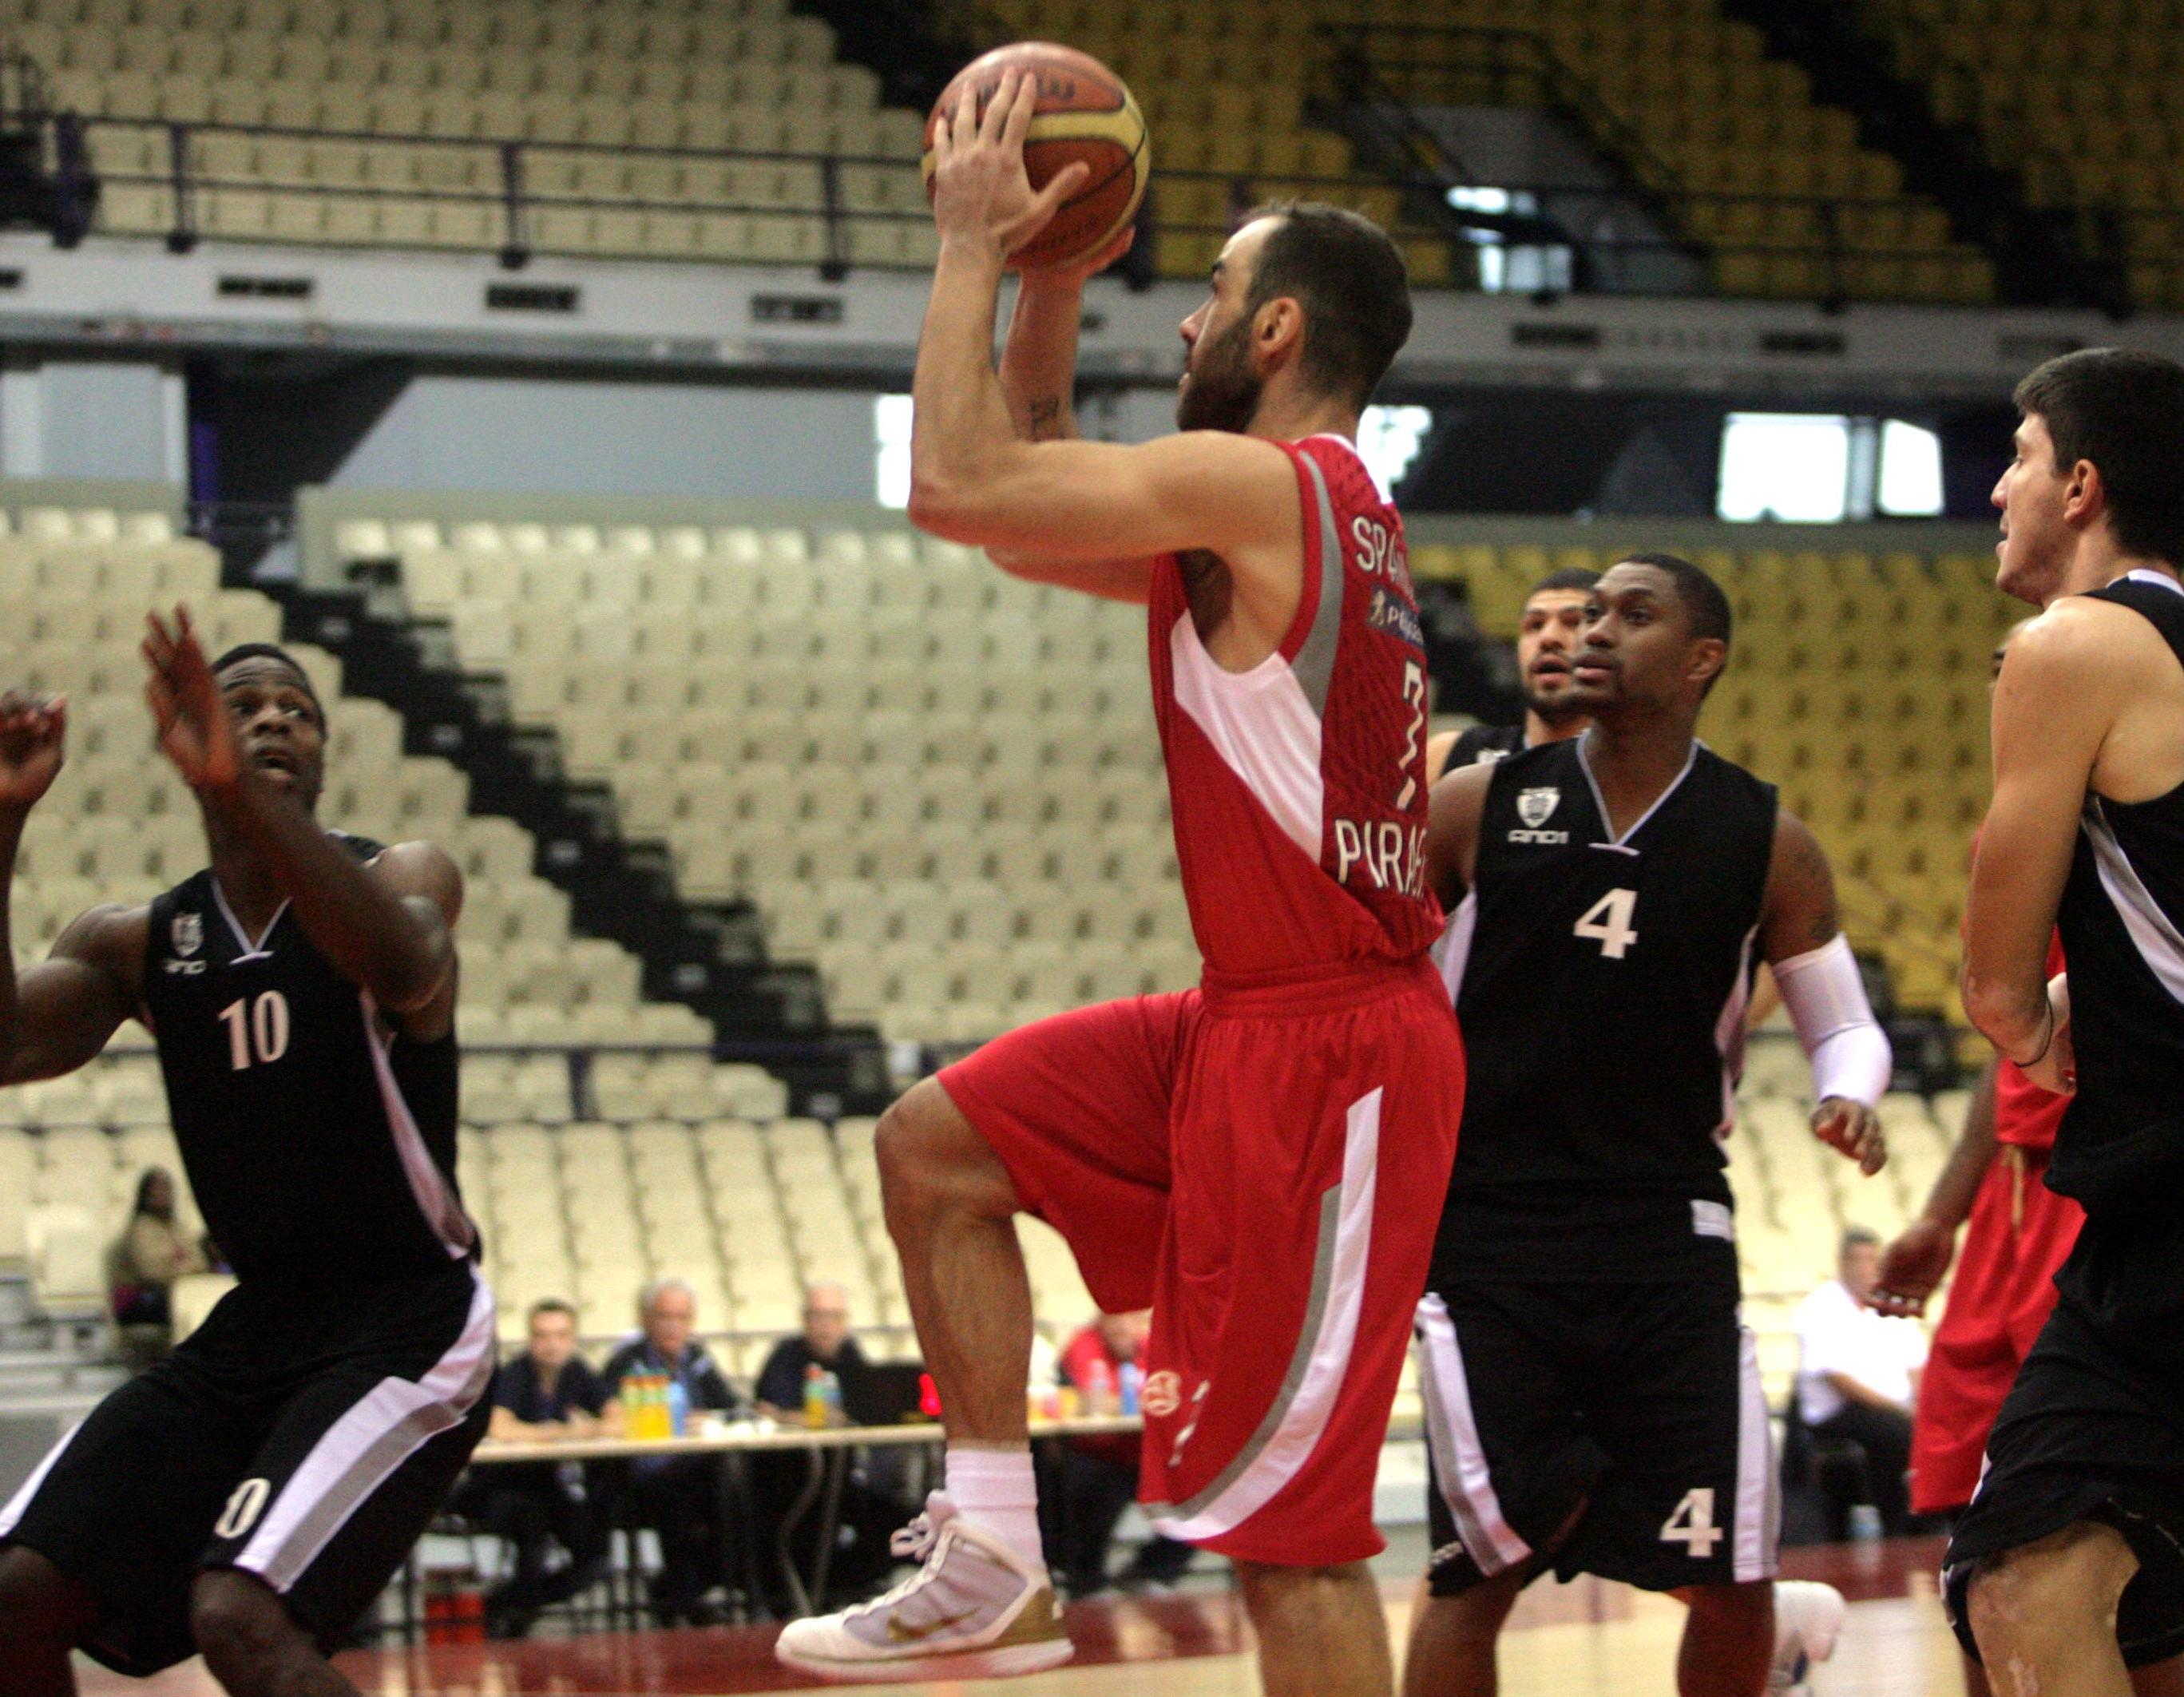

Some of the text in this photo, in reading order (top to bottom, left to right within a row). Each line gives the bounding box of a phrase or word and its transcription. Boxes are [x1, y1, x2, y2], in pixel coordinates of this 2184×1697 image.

[1572, 887, 1639, 959] 4
[217, 990, 291, 1071] 10
[1659, 1487, 1724, 1557] 4
